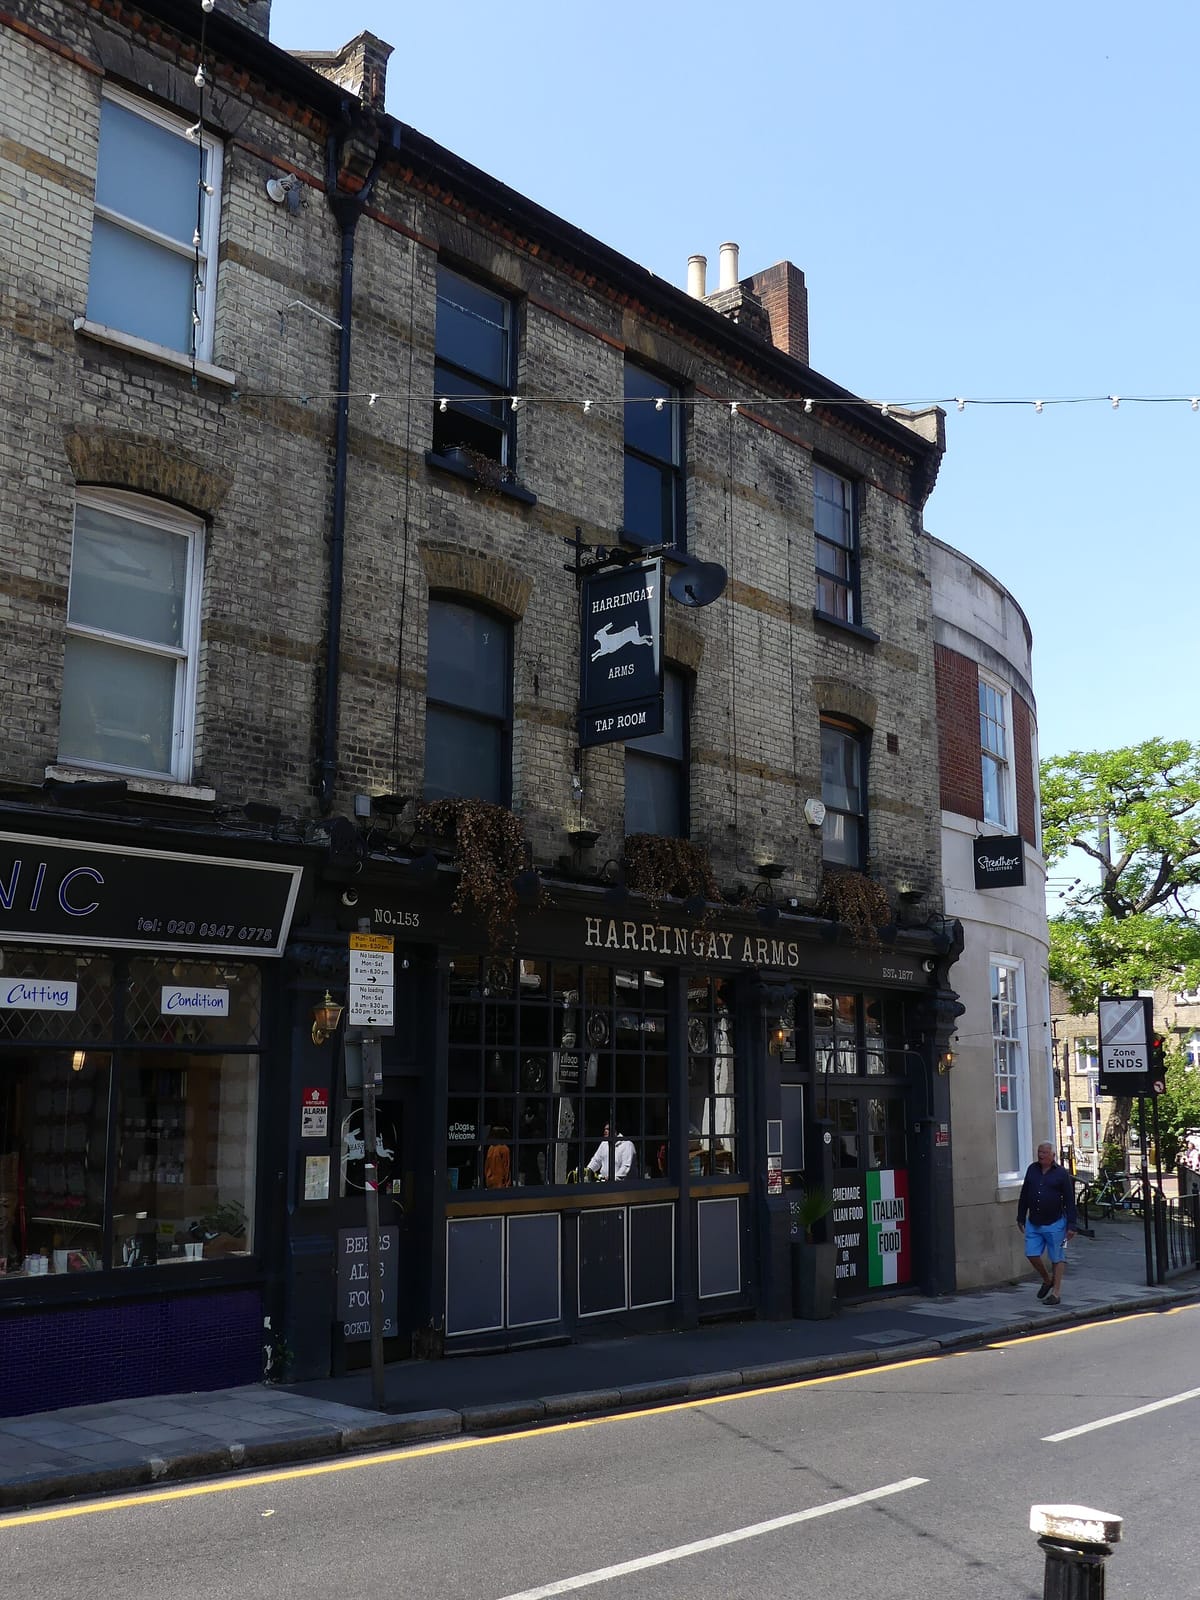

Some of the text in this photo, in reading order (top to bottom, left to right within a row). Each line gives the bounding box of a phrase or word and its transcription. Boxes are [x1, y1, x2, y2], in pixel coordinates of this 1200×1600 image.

[591, 585, 655, 613] HARRINGAY
[608, 663, 635, 680] ARMS
[594, 711, 646, 733] TAP ROOM
[977, 855, 1021, 870] Streathers
[373, 907, 420, 927] NO.153
[167, 920, 195, 935] 020
[199, 922, 235, 938] 8347
[238, 926, 273, 941] 6775
[584, 916, 800, 967] HARRINGAY ARMS
[882, 967, 897, 978] EST.
[7, 983, 68, 1006] Cutting
[167, 992, 224, 1009] Condition
[1113, 1048, 1136, 1056] Zone
[1107, 1058, 1143, 1068] ENDS
[454, 1122, 469, 1131] Dogs
[447, 1131, 476, 1140] Welcome
[832, 1186, 861, 1201] OMEMADE
[849, 1206, 864, 1220] FOOD
[872, 1199, 904, 1221] ITALIAN
[878, 1232, 900, 1253] FOOD
[842, 1250, 849, 1262] OR
[835, 1263, 857, 1279] DINE IN
